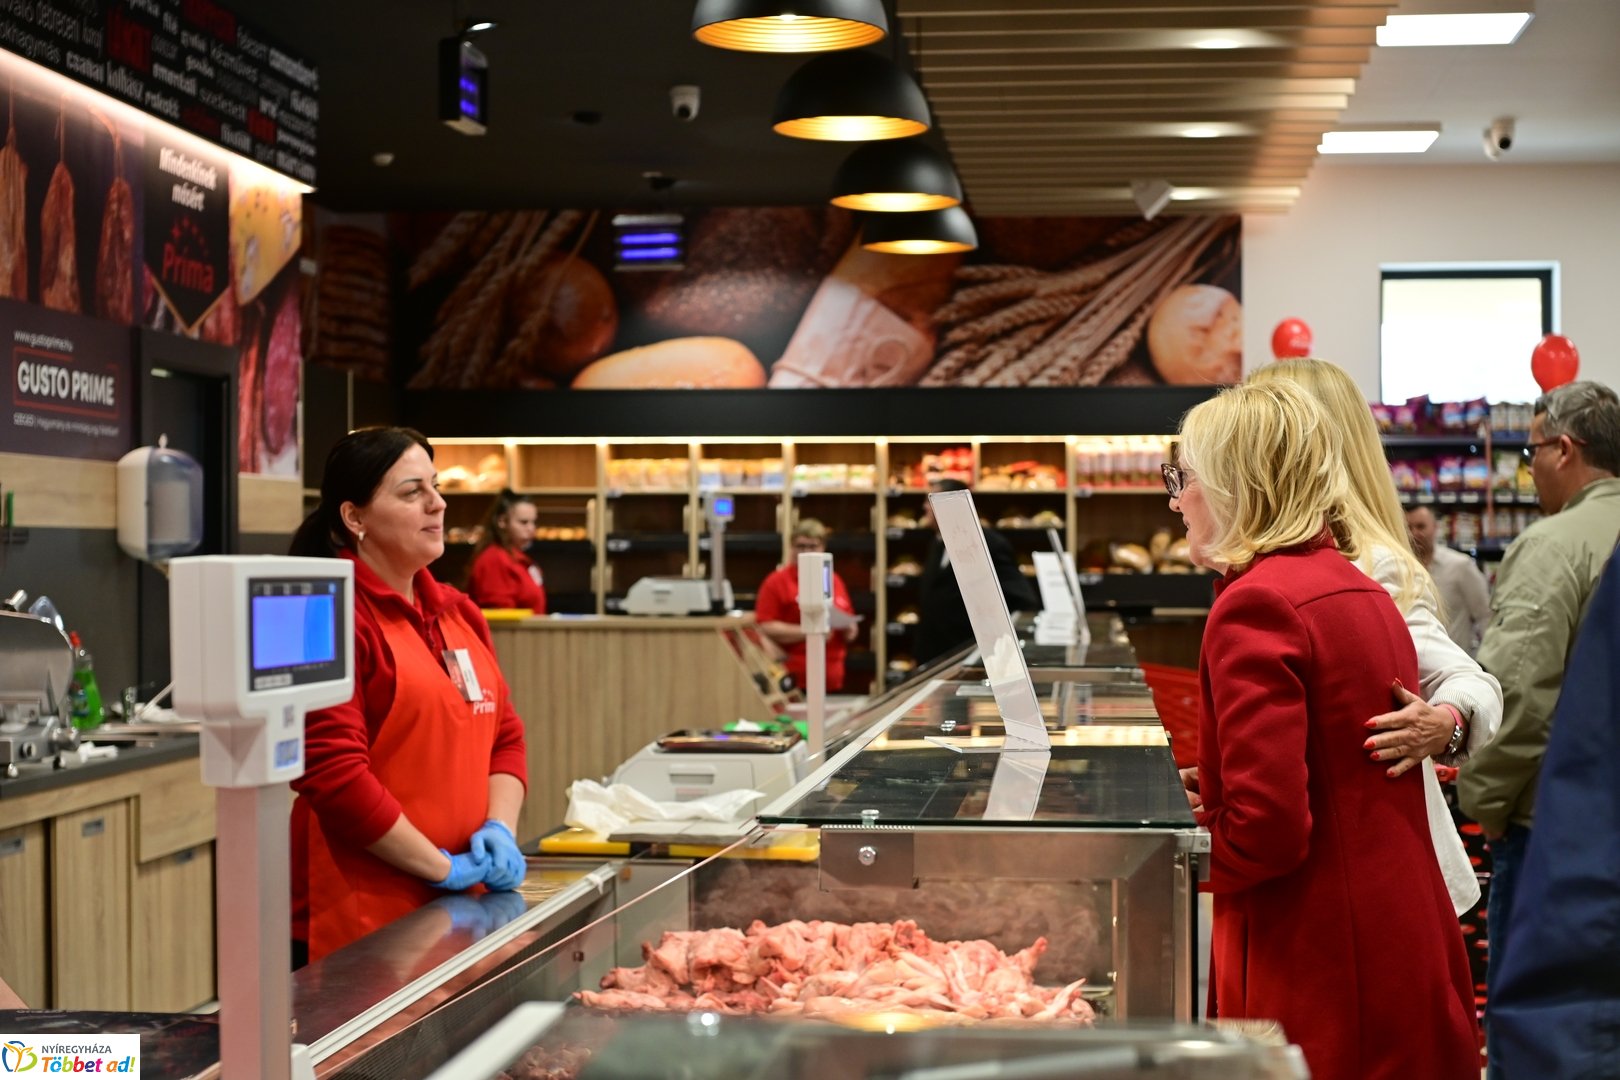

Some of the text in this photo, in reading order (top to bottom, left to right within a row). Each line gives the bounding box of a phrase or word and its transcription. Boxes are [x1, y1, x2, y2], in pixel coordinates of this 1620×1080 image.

[0, 20, 62, 65] okhagymás
[17, 360, 115, 406] GUSTO PRIME
